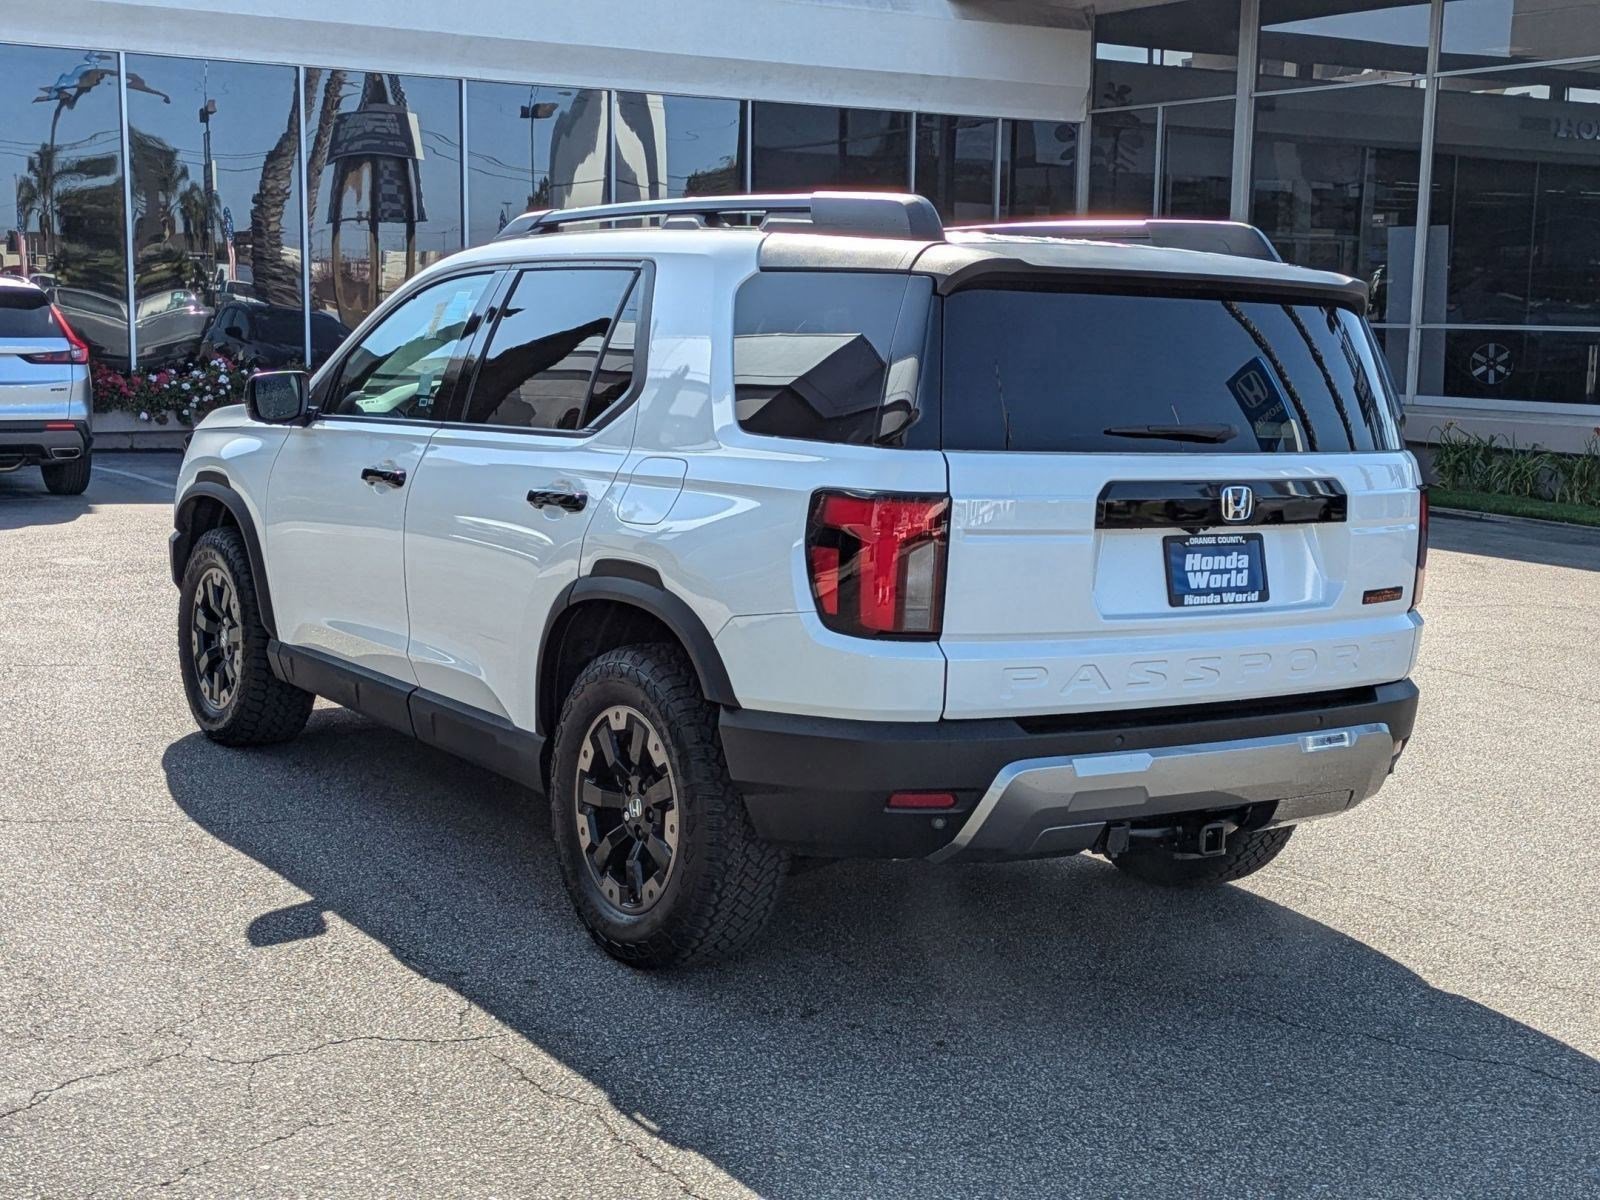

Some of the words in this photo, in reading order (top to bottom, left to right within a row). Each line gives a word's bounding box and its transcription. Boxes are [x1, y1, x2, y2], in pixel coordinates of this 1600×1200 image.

[1189, 537, 1217, 545] ORANGE
[1217, 536, 1243, 544] COUNTY
[1185, 552, 1249, 570] Honda
[1187, 568, 1249, 589] World
[1184, 593, 1221, 605] Honda
[1221, 591, 1259, 603] World
[1000, 639, 1397, 700] PASSPORT
